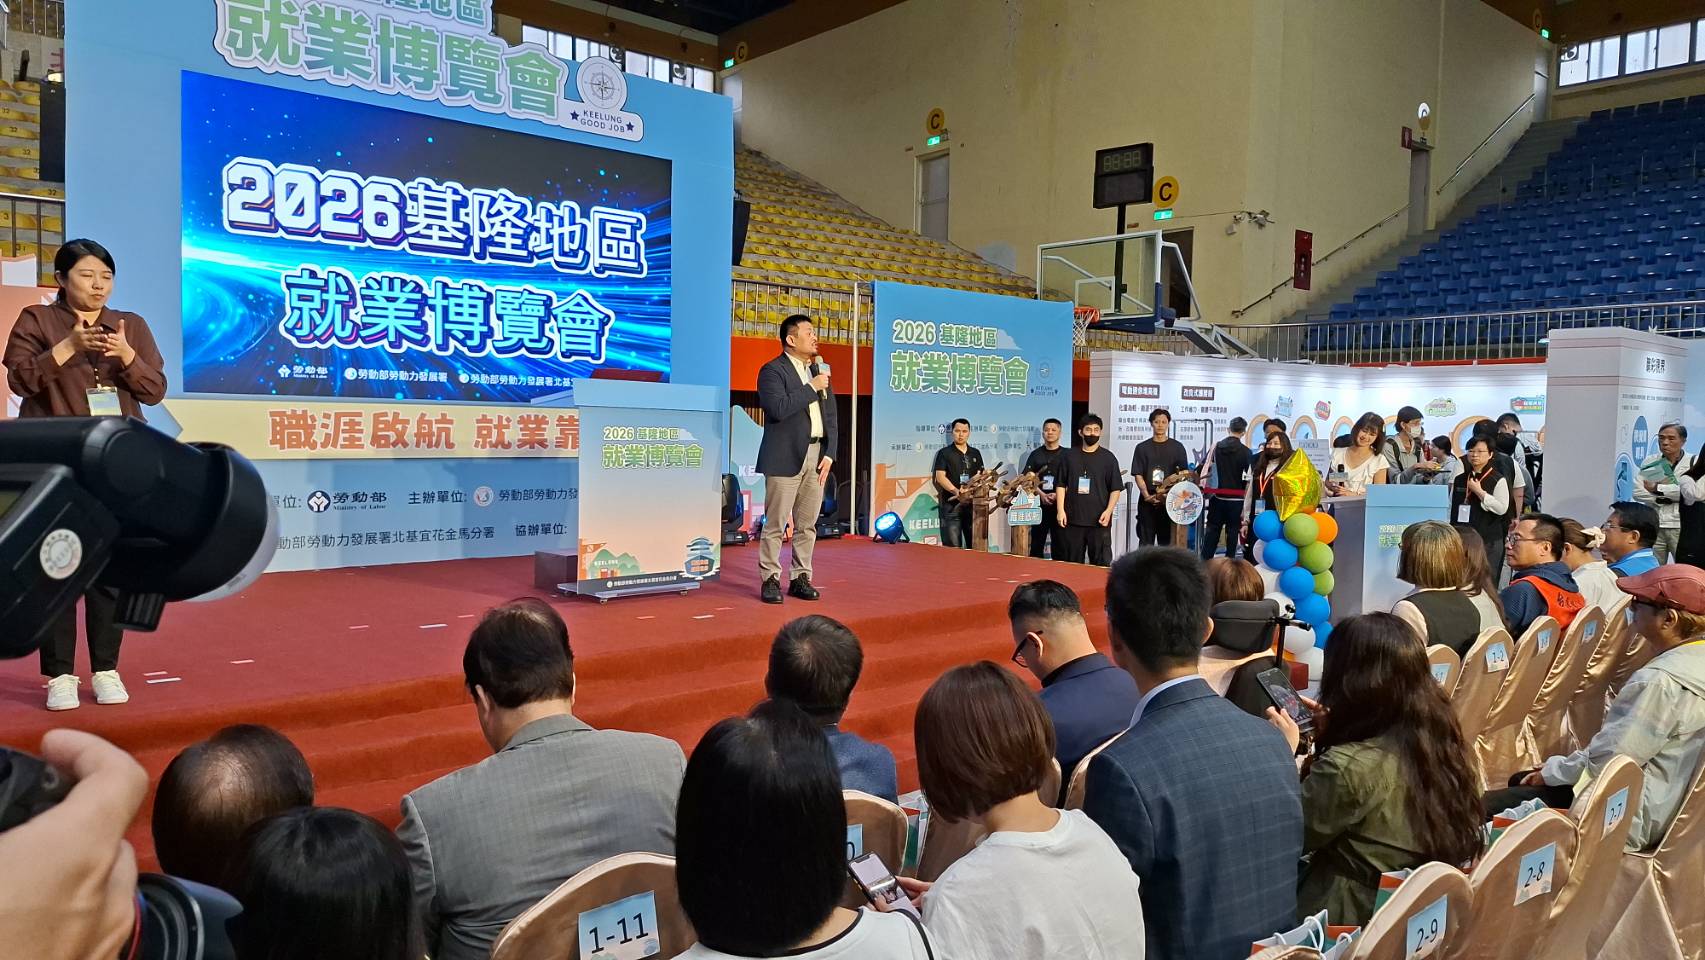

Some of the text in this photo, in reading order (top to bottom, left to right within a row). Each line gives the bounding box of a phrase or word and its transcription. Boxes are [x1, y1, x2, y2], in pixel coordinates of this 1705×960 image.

[226, 0, 562, 118] 就業博覽會
[580, 118, 625, 133] GOOD JOB
[583, 109, 623, 124] KEELUNG
[930, 113, 940, 130] C
[1159, 182, 1172, 201] C
[225, 160, 642, 272] 2026基隆地區
[284, 270, 609, 357] 就業博覽會
[892, 320, 998, 349] 2026 基隆地區
[470, 373, 573, 387] 勞動部勞動力發展署北基
[890, 350, 1029, 395] 就業博覽會
[268, 408, 457, 450] 職涯啟航
[603, 427, 634, 440] 2026
[602, 444, 703, 468] 就業博覽會
[333, 491, 387, 504] 勞動部
[1491, 650, 1505, 664] 1-2
[1608, 802, 1623, 826] 2-7
[1524, 861, 1545, 888] 2-8
[589, 912, 649, 954] 1-11
[1415, 918, 1438, 952] 2-9
